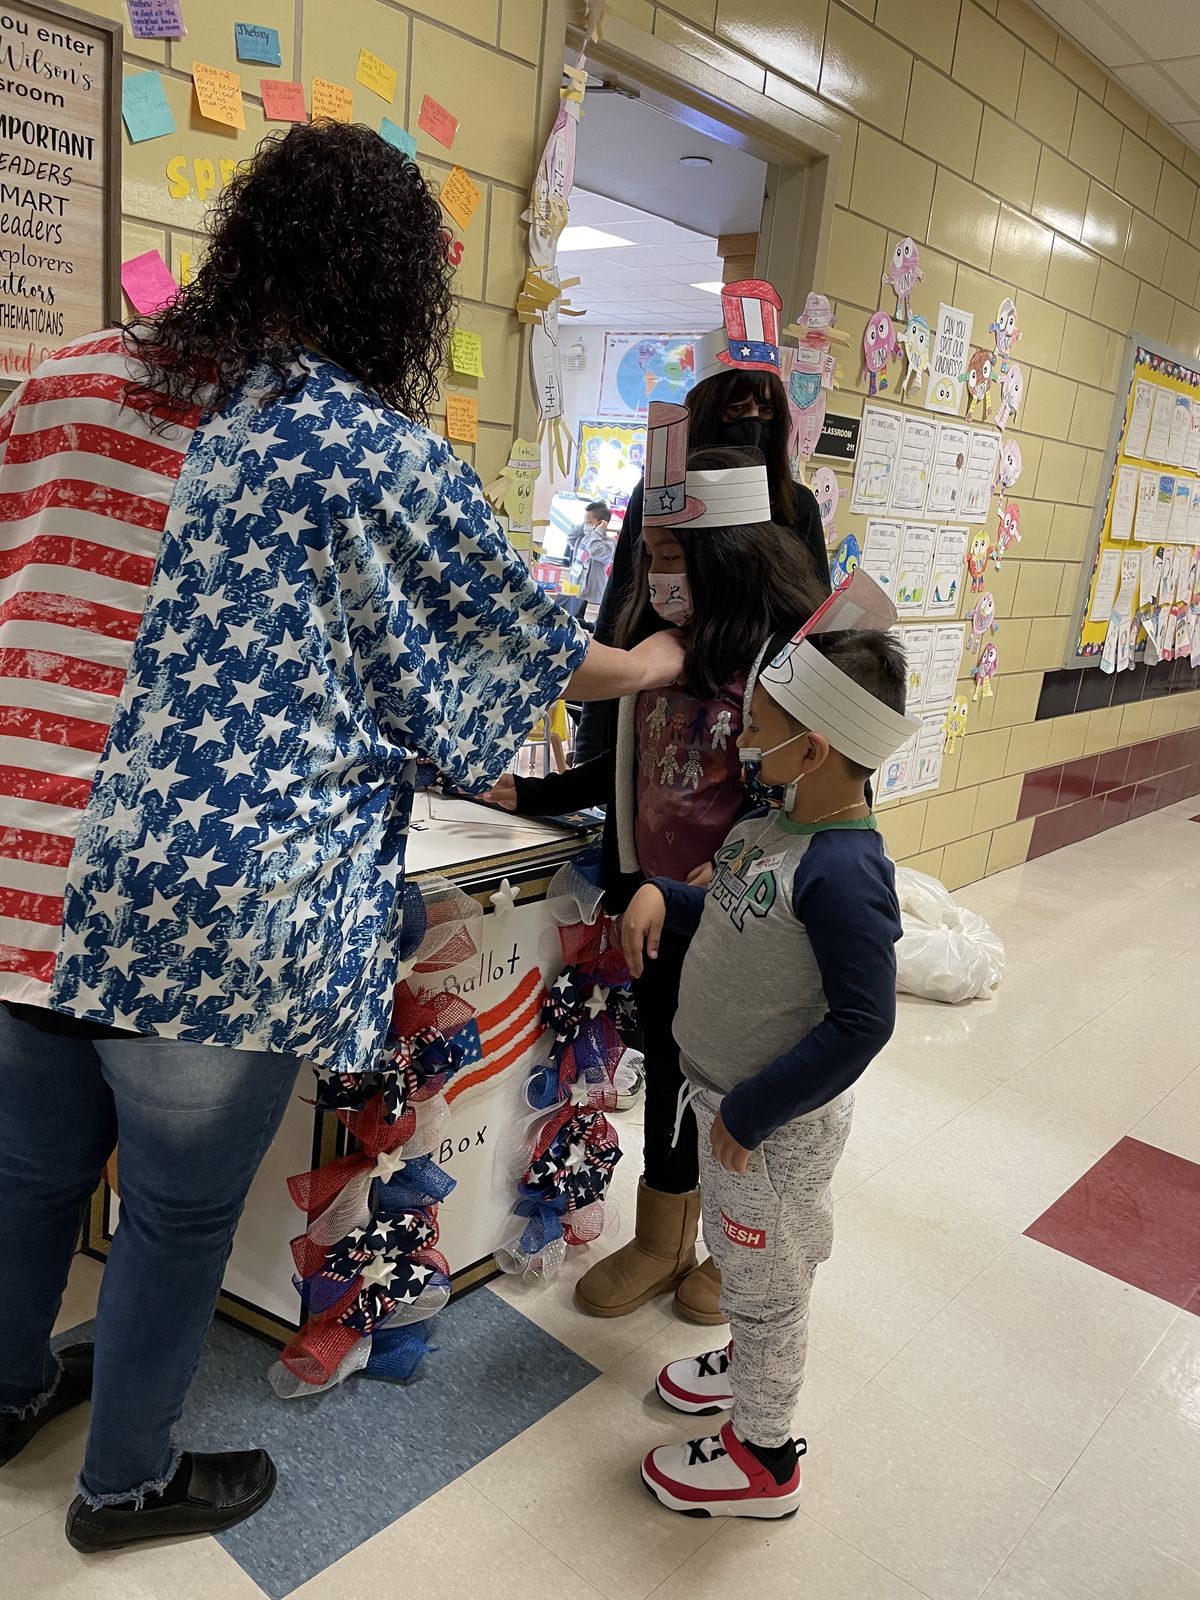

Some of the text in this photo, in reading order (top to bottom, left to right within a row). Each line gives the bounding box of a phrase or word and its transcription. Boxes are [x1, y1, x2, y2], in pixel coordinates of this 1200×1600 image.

[37, 28, 94, 56] enter
[0, 35, 94, 91] Wilson's
[0, 183, 70, 216] MART
[0, 208, 62, 244] eaders
[943, 315, 967, 339] CAN YOU
[0, 342, 36, 376] ved
[939, 335, 965, 358] SPOT OUR
[934, 354, 963, 379] KINDNESS?
[821, 426, 852, 439] CLASSROOM
[846, 443, 855, 452] 211
[442, 943, 521, 997] Ballot
[438, 1125, 488, 1165] Box
